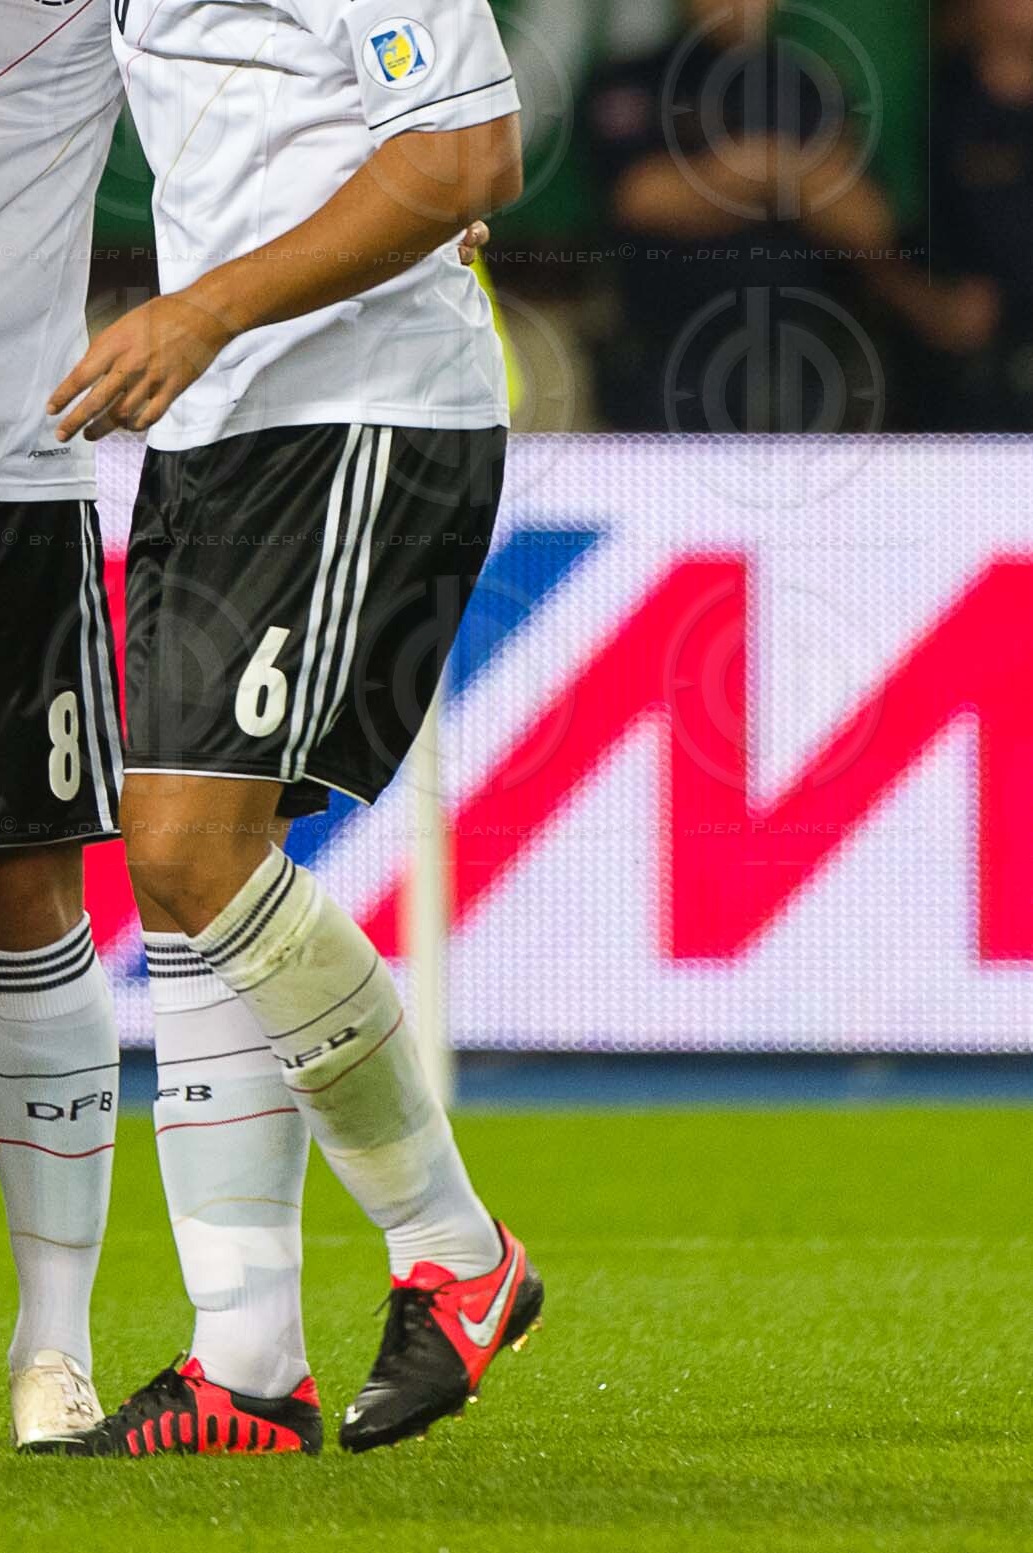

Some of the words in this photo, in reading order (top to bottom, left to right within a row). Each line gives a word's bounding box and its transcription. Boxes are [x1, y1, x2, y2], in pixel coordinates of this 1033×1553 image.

[234, 626, 291, 737] 6
[48, 690, 81, 801] 8
[25, 1090, 114, 1122] DFB
